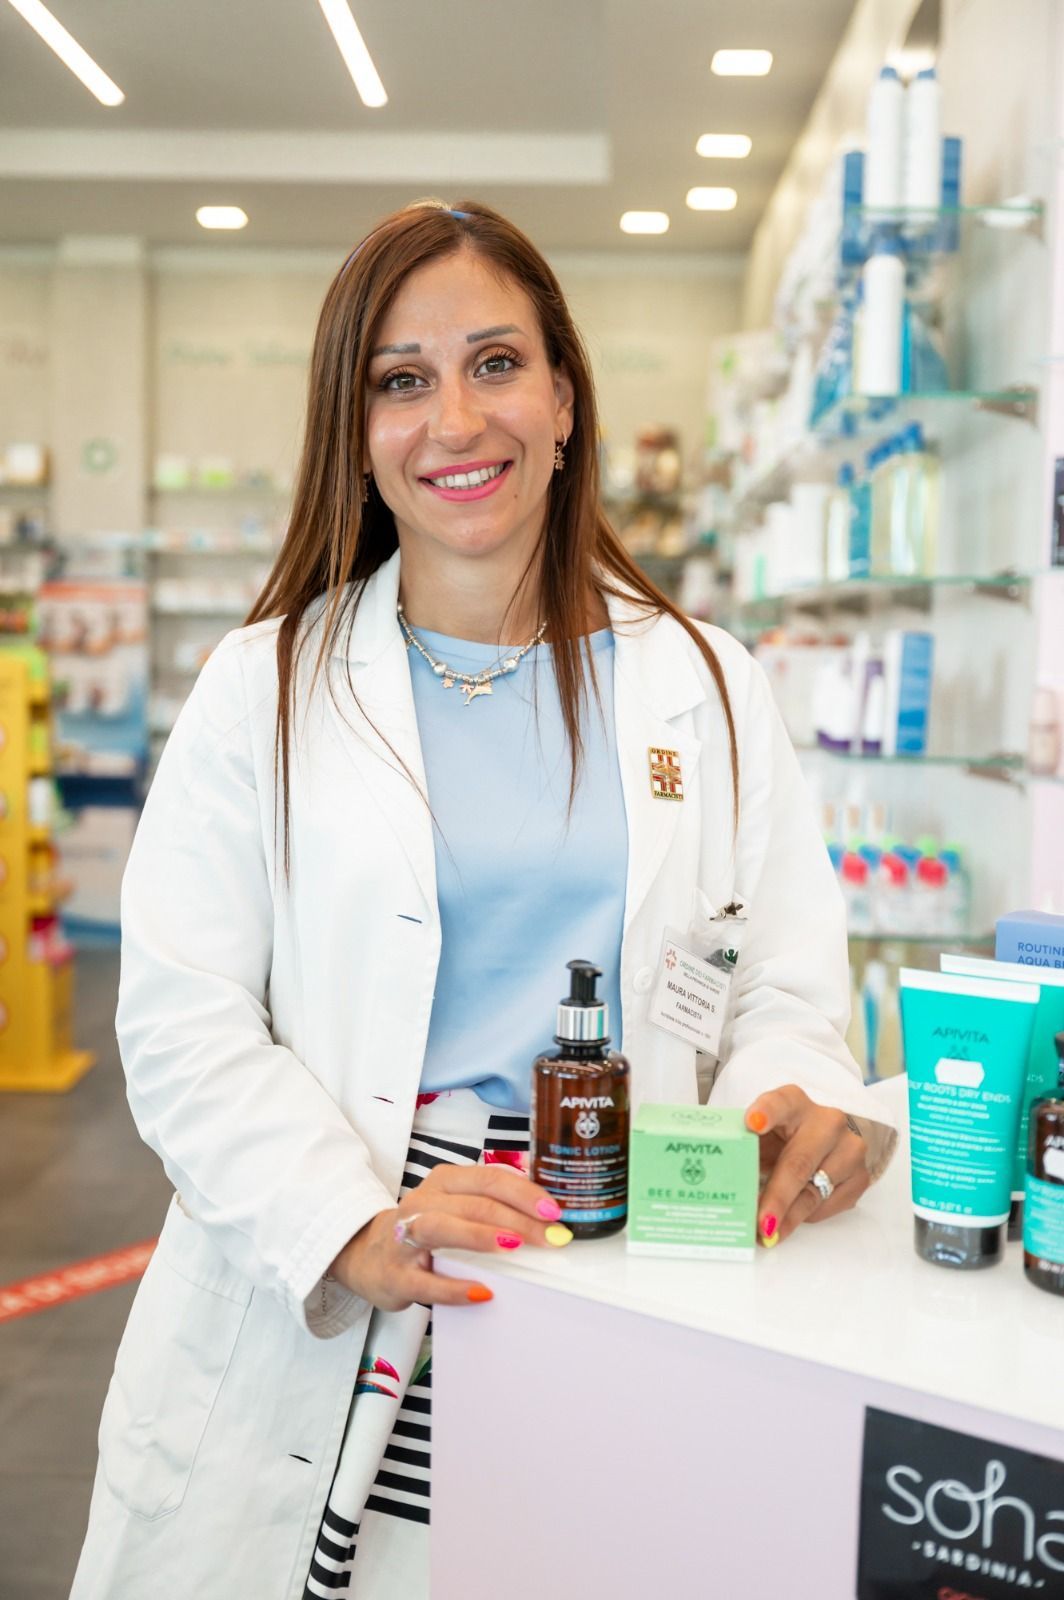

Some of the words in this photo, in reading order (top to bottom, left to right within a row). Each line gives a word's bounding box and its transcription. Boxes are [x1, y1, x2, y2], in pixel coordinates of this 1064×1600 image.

[651, 748, 677, 756] ORDINE
[1017, 955, 1050, 968] AQUA
[667, 981, 687, 999] MAURA
[687, 993, 713, 1010] VITTORIA
[675, 1002, 702, 1020] FARMACISTA
[932, 1026, 990, 1043] APIVITA
[923, 1082, 957, 1097] ROOTS
[958, 1087, 980, 1099] DRY
[981, 1091, 1012, 1103] ENDS
[560, 1096, 615, 1109] APIVITA
[549, 1143, 582, 1156] TONIC
[584, 1144, 621, 1156] LOTION
[665, 1142, 723, 1155] APIVITA
[648, 1187, 672, 1198] BEE
[678, 1189, 737, 1200] RADIANT
[923, 1540, 1032, 1588] SARDINIA
